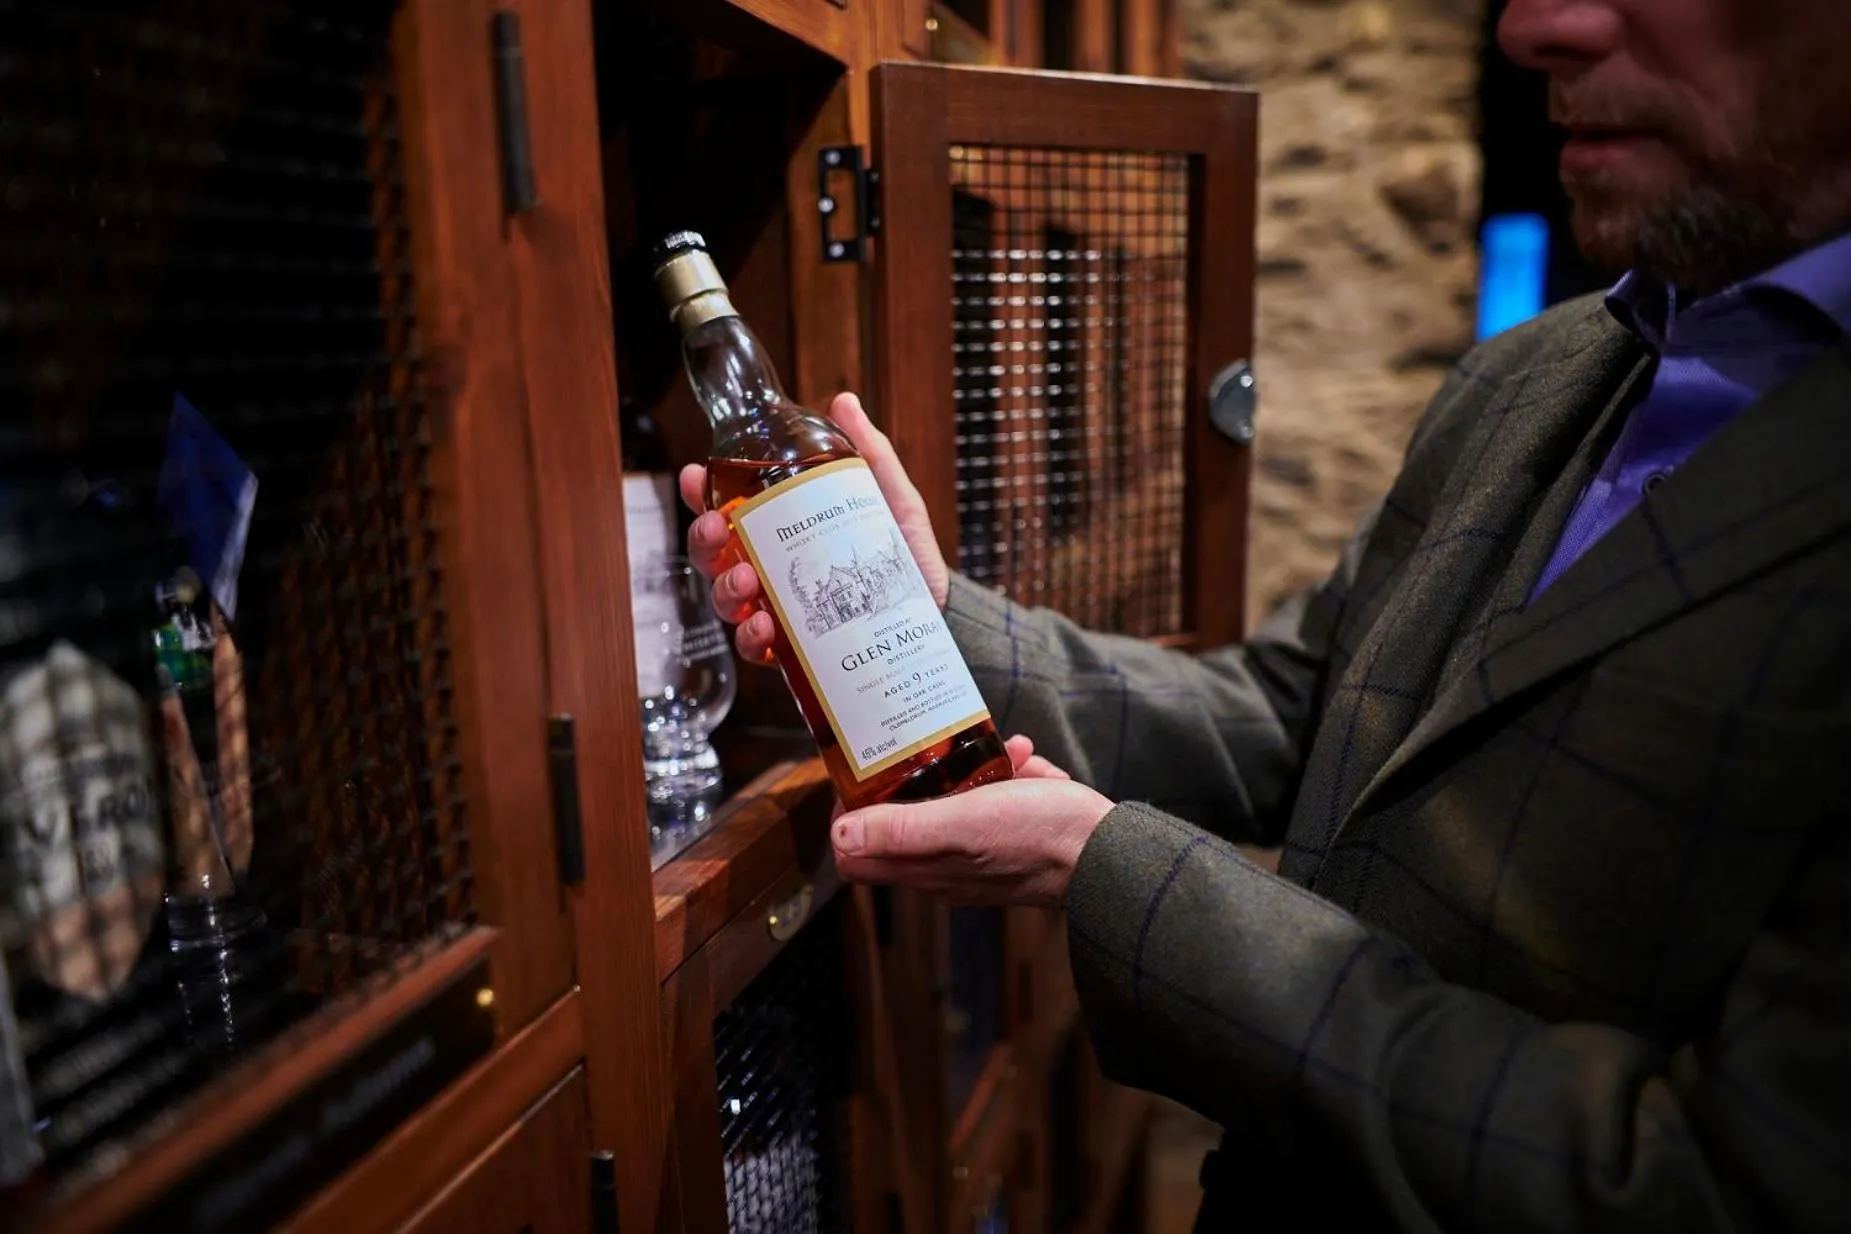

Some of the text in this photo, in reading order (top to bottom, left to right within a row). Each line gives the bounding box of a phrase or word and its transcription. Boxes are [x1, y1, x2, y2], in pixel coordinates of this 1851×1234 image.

[776, 505, 845, 542] MELDRUM
[874, 620, 905, 638] DISTILLED
[841, 640, 892, 671] GLEN
[887, 644, 925, 665] DISTILLERY
[856, 676, 883, 694] SINGLE
[884, 681, 911, 698] AGED
[912, 671, 922, 684] 9
